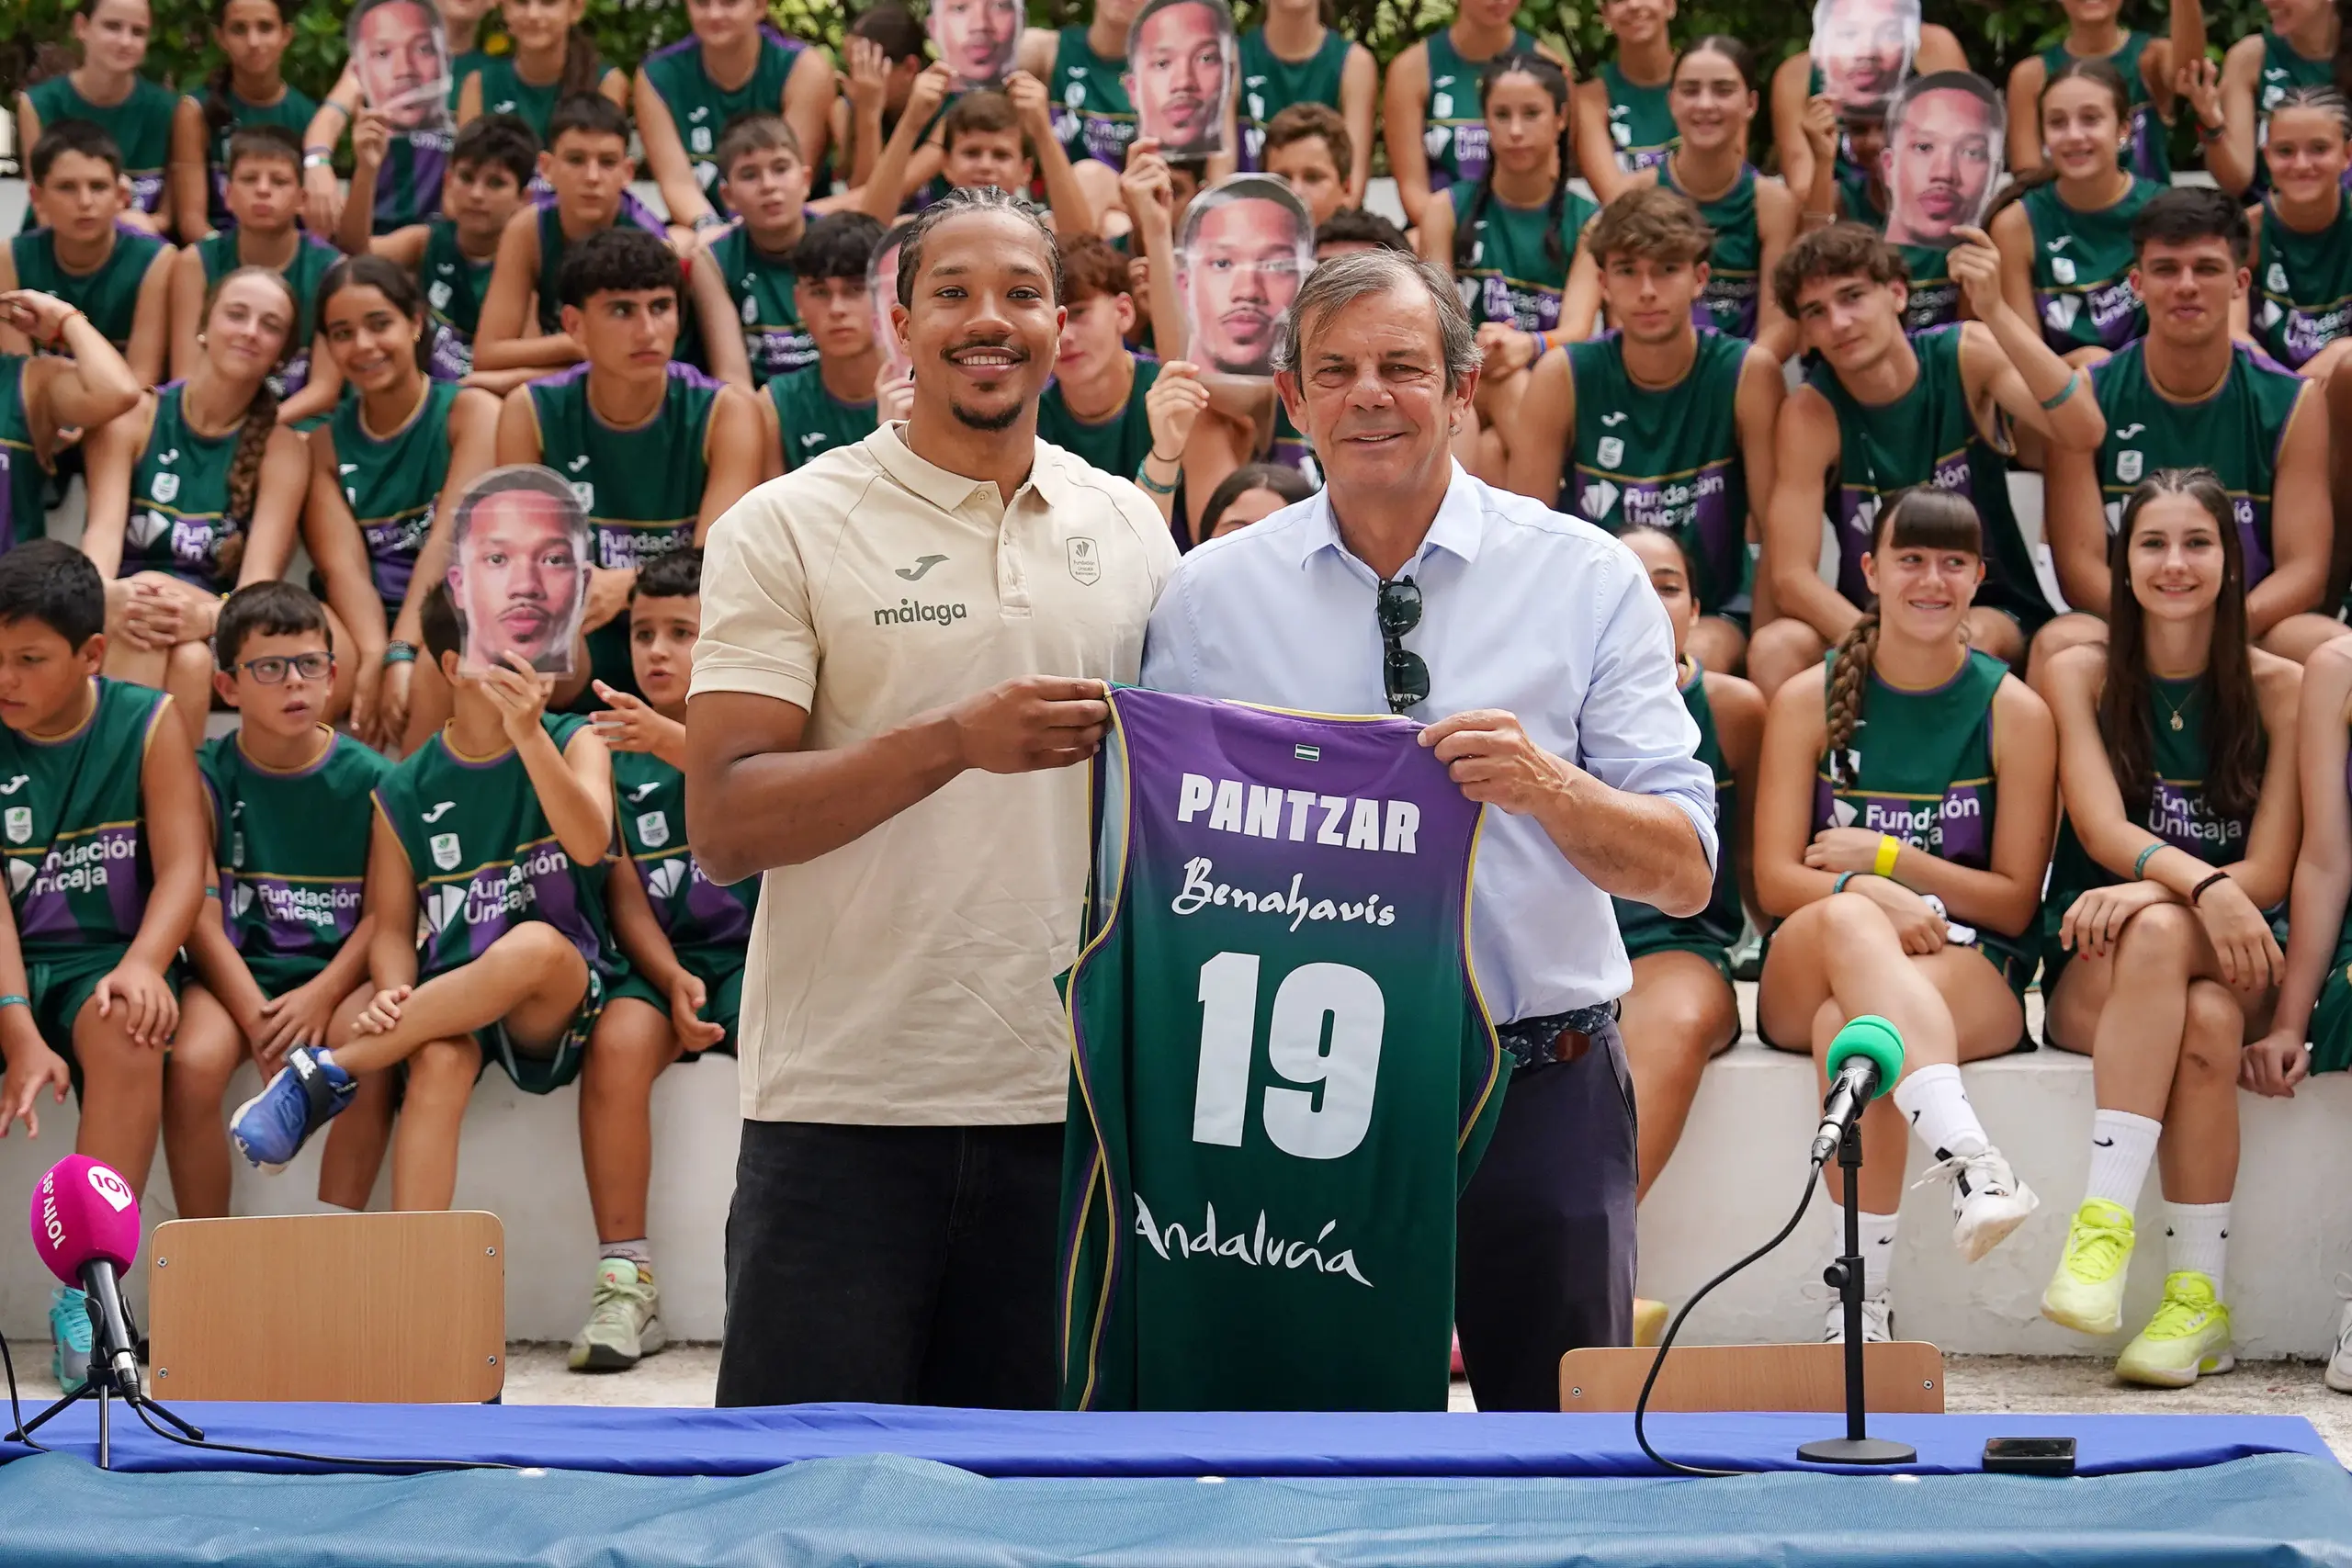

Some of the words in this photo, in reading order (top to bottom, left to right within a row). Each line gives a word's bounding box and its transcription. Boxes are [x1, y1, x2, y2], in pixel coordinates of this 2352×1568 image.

[1177, 773, 1421, 854] PANTZAR
[2148, 808, 2242, 845] Unicaja
[1192, 951, 1385, 1160] 19
[93, 1173, 129, 1199] 101
[1134, 1191, 1374, 1288] Andalucía
